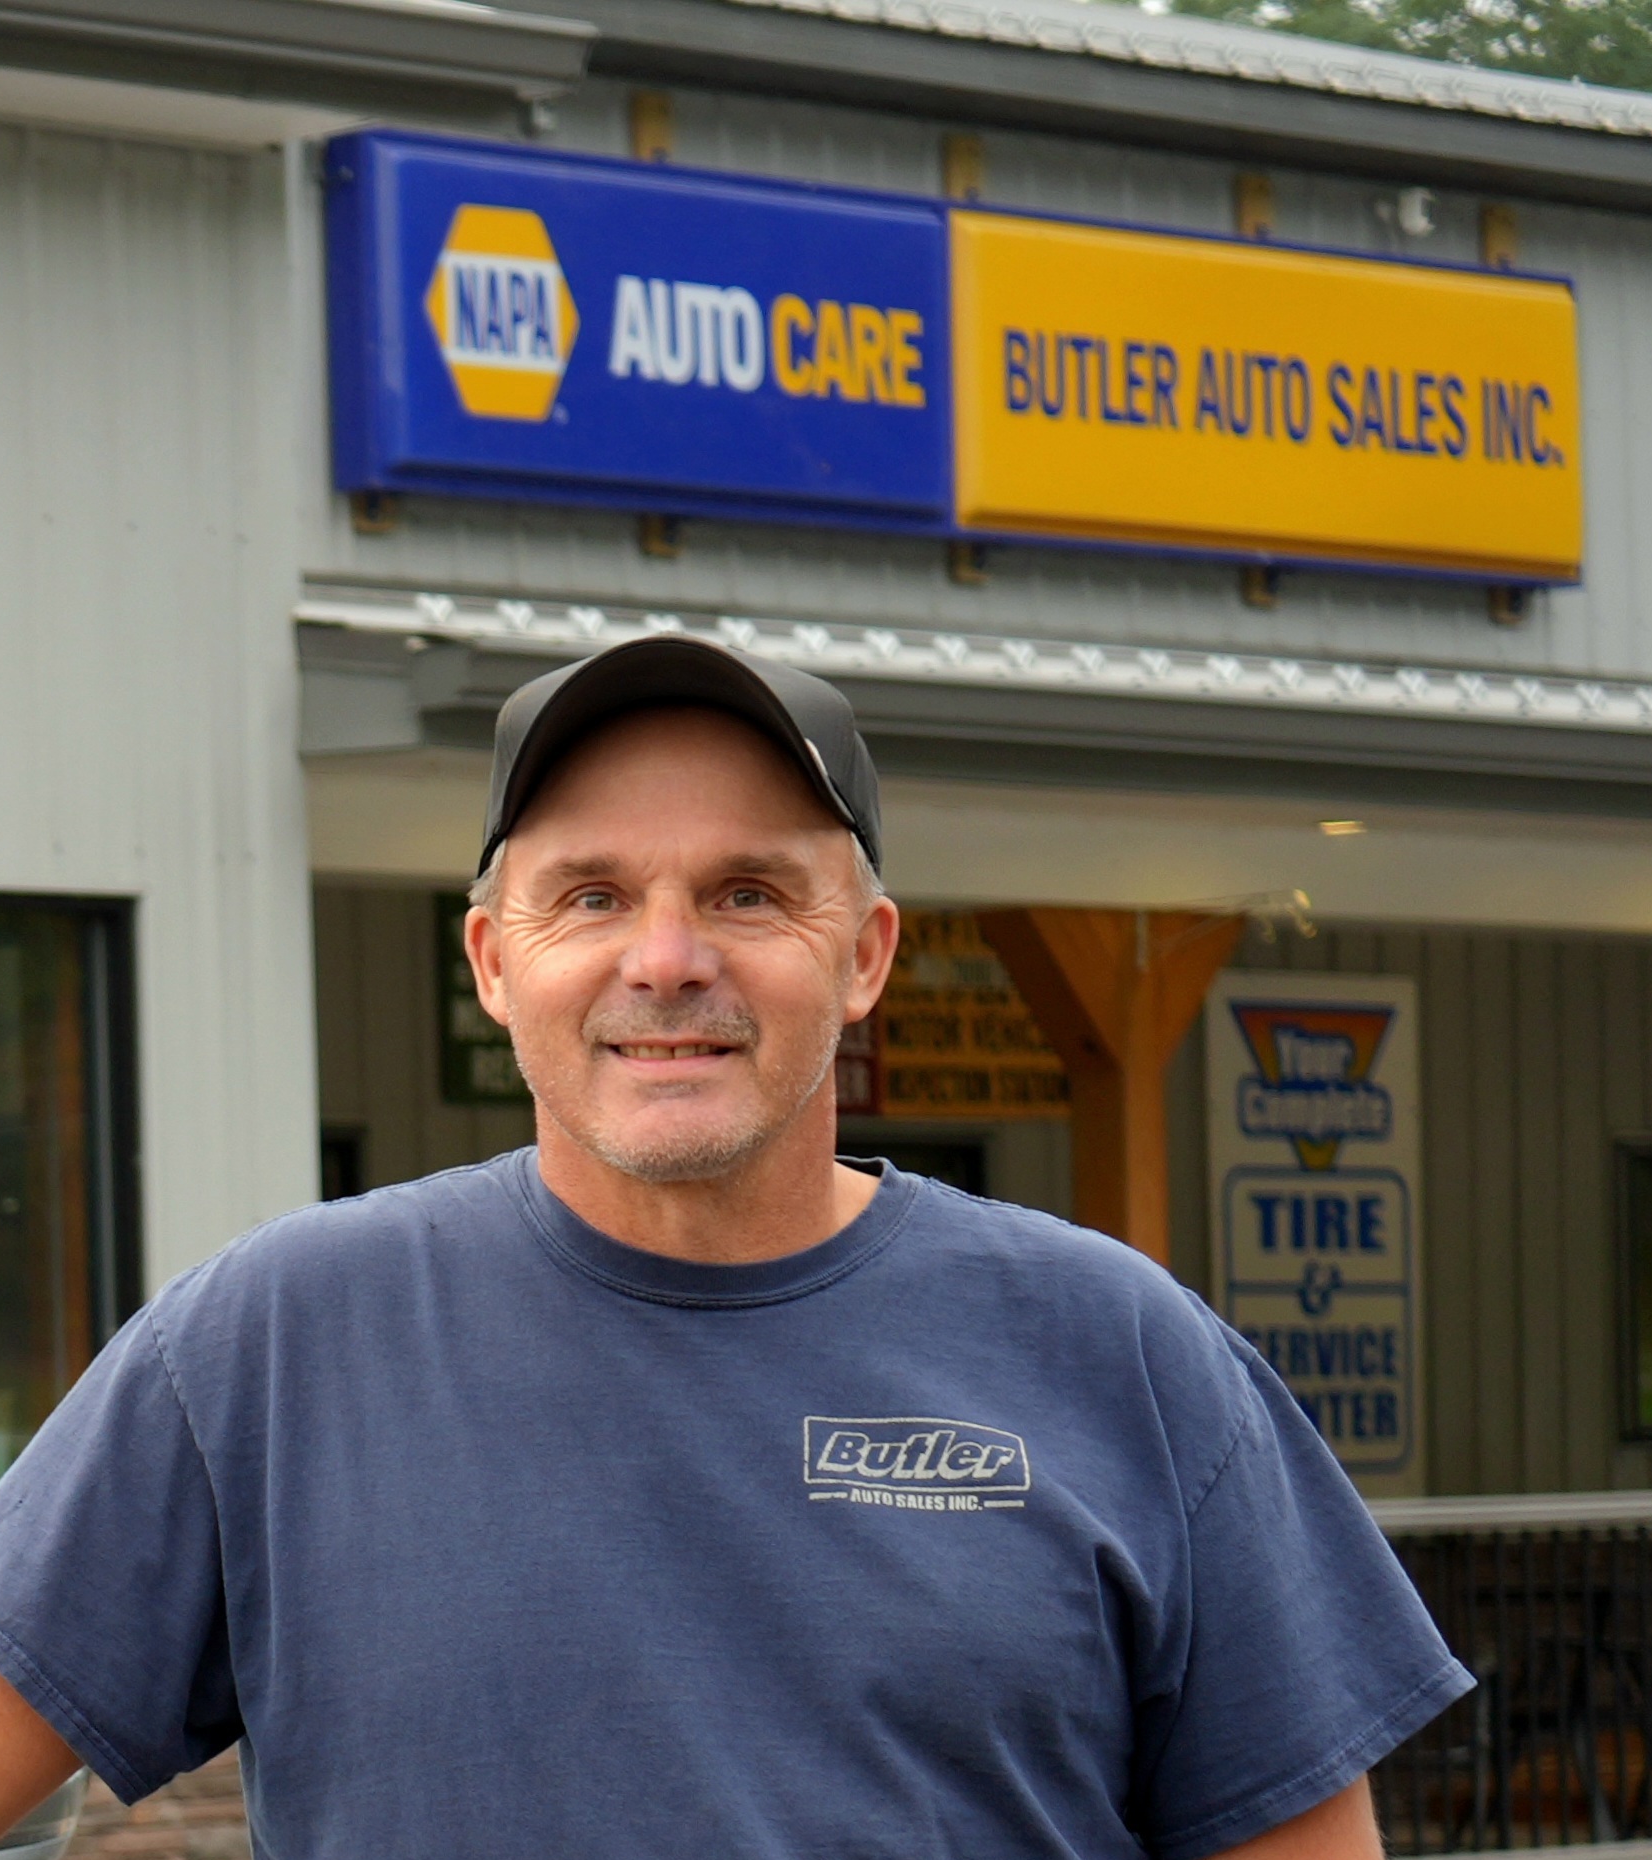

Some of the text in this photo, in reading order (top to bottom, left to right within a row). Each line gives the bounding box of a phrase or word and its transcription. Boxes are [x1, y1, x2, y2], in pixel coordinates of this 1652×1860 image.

[452, 261, 557, 361] NAPA
[608, 273, 927, 409] AUTO CARE
[1002, 327, 1566, 469] BUTLER AUTO SALES INC.
[1250, 1191, 1388, 1250] TIRE
[816, 1430, 1016, 1480] Butler
[850, 1488, 984, 1512] AUTO SALES INC.
